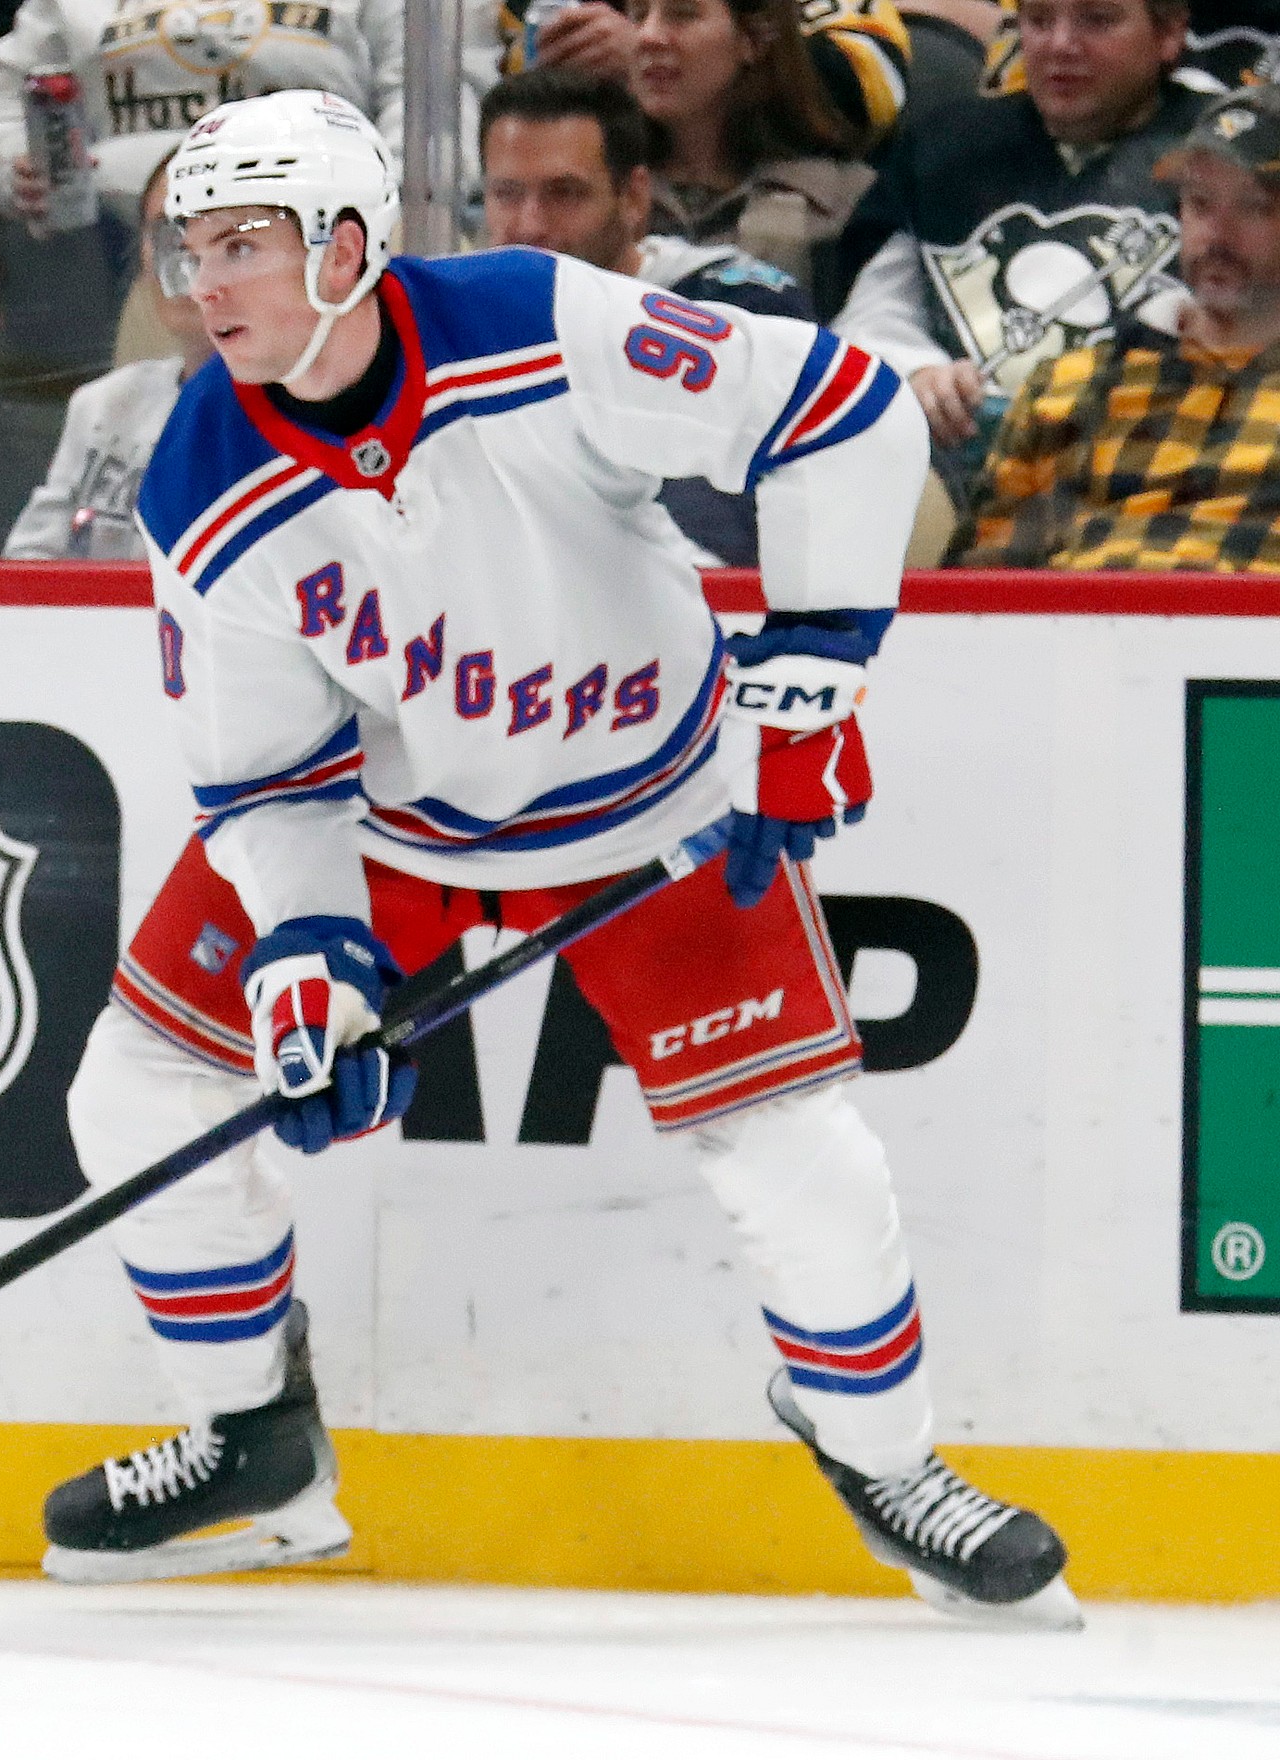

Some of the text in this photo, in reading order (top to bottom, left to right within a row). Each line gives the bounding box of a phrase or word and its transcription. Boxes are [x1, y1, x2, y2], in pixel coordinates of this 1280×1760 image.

[624, 293, 734, 393] 90
[296, 561, 660, 739] RANGERS
[730, 682, 837, 711] CM
[648, 988, 785, 1060] CCM
